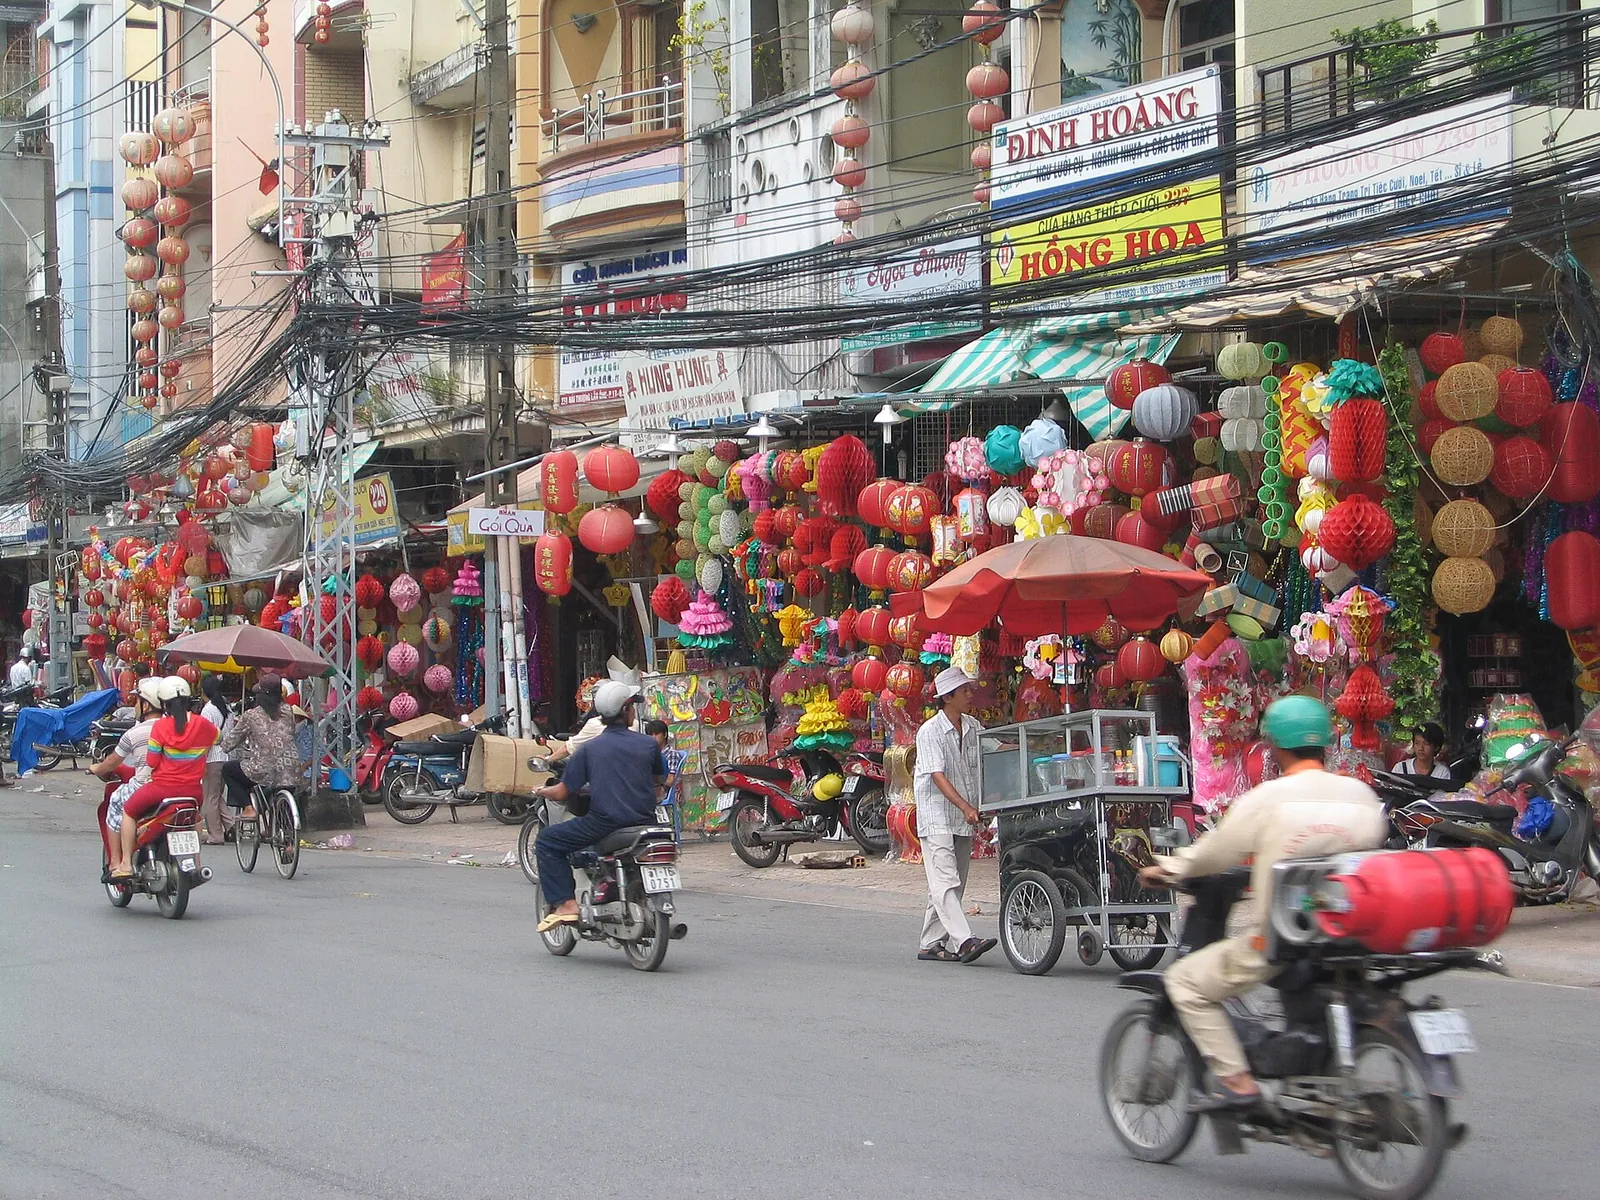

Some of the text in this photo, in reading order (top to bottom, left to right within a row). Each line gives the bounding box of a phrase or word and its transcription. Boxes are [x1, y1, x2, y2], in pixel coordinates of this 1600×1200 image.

[1007, 122, 1080, 164] ĐÌNH
[1090, 86, 1198, 142] HOÀNG
[1435, 122, 1477, 153] 239
[1430, 167, 1442, 182] Tết
[1020, 223, 1206, 281] HỒNG HOA
[651, 878, 675, 890] 0751
